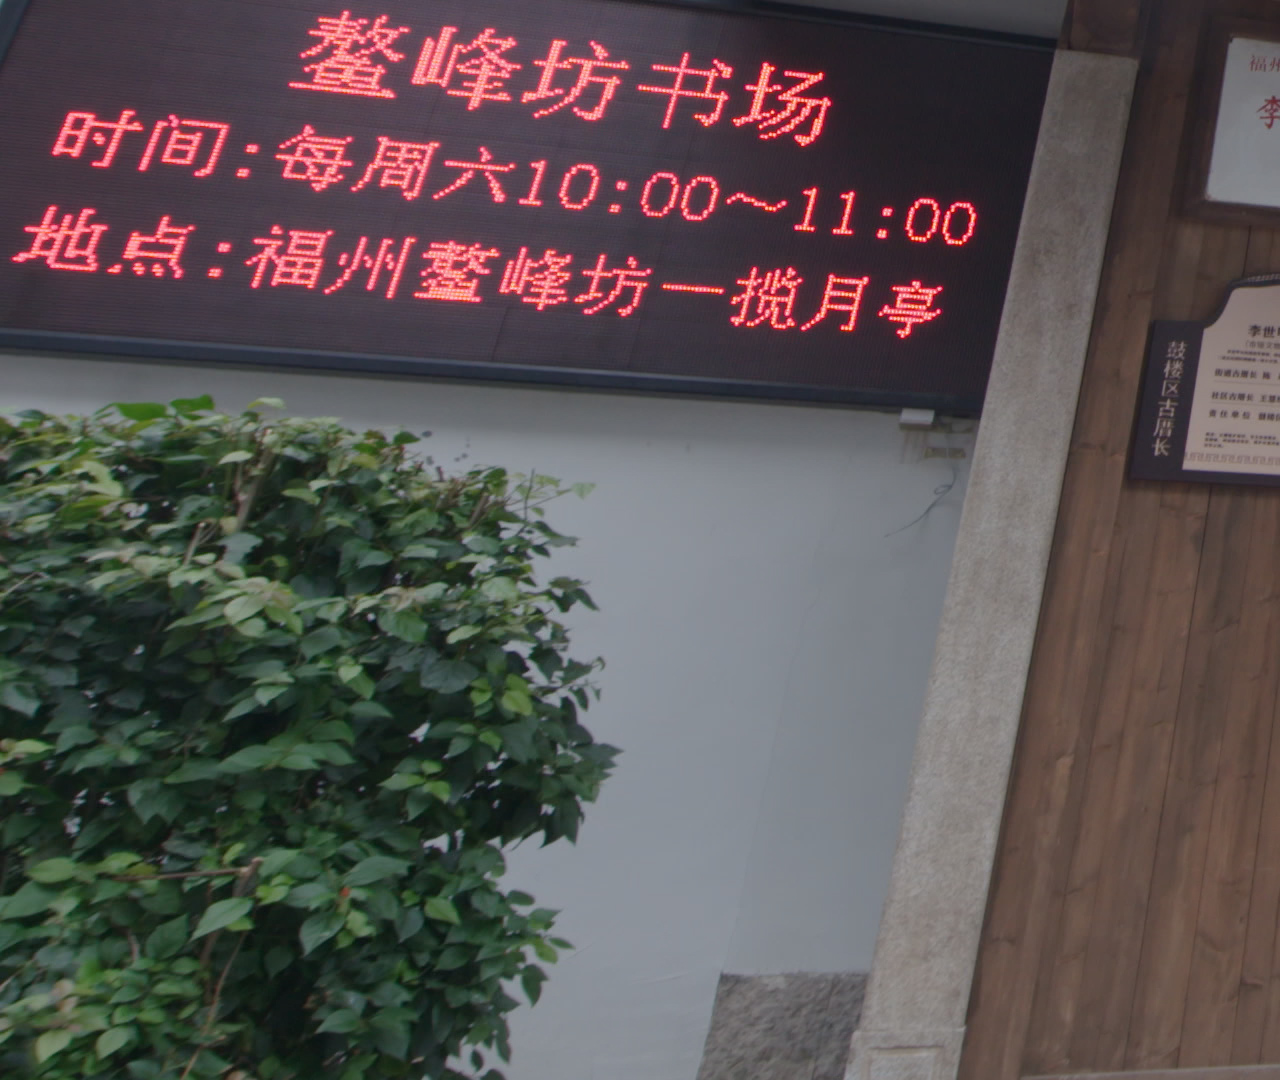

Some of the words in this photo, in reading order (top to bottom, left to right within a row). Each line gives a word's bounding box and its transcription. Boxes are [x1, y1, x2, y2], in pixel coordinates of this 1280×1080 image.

[288, 10, 832, 147] 鳌峰坊书场
[1152, 341, 1187, 456] 鼓楼区古厝长
